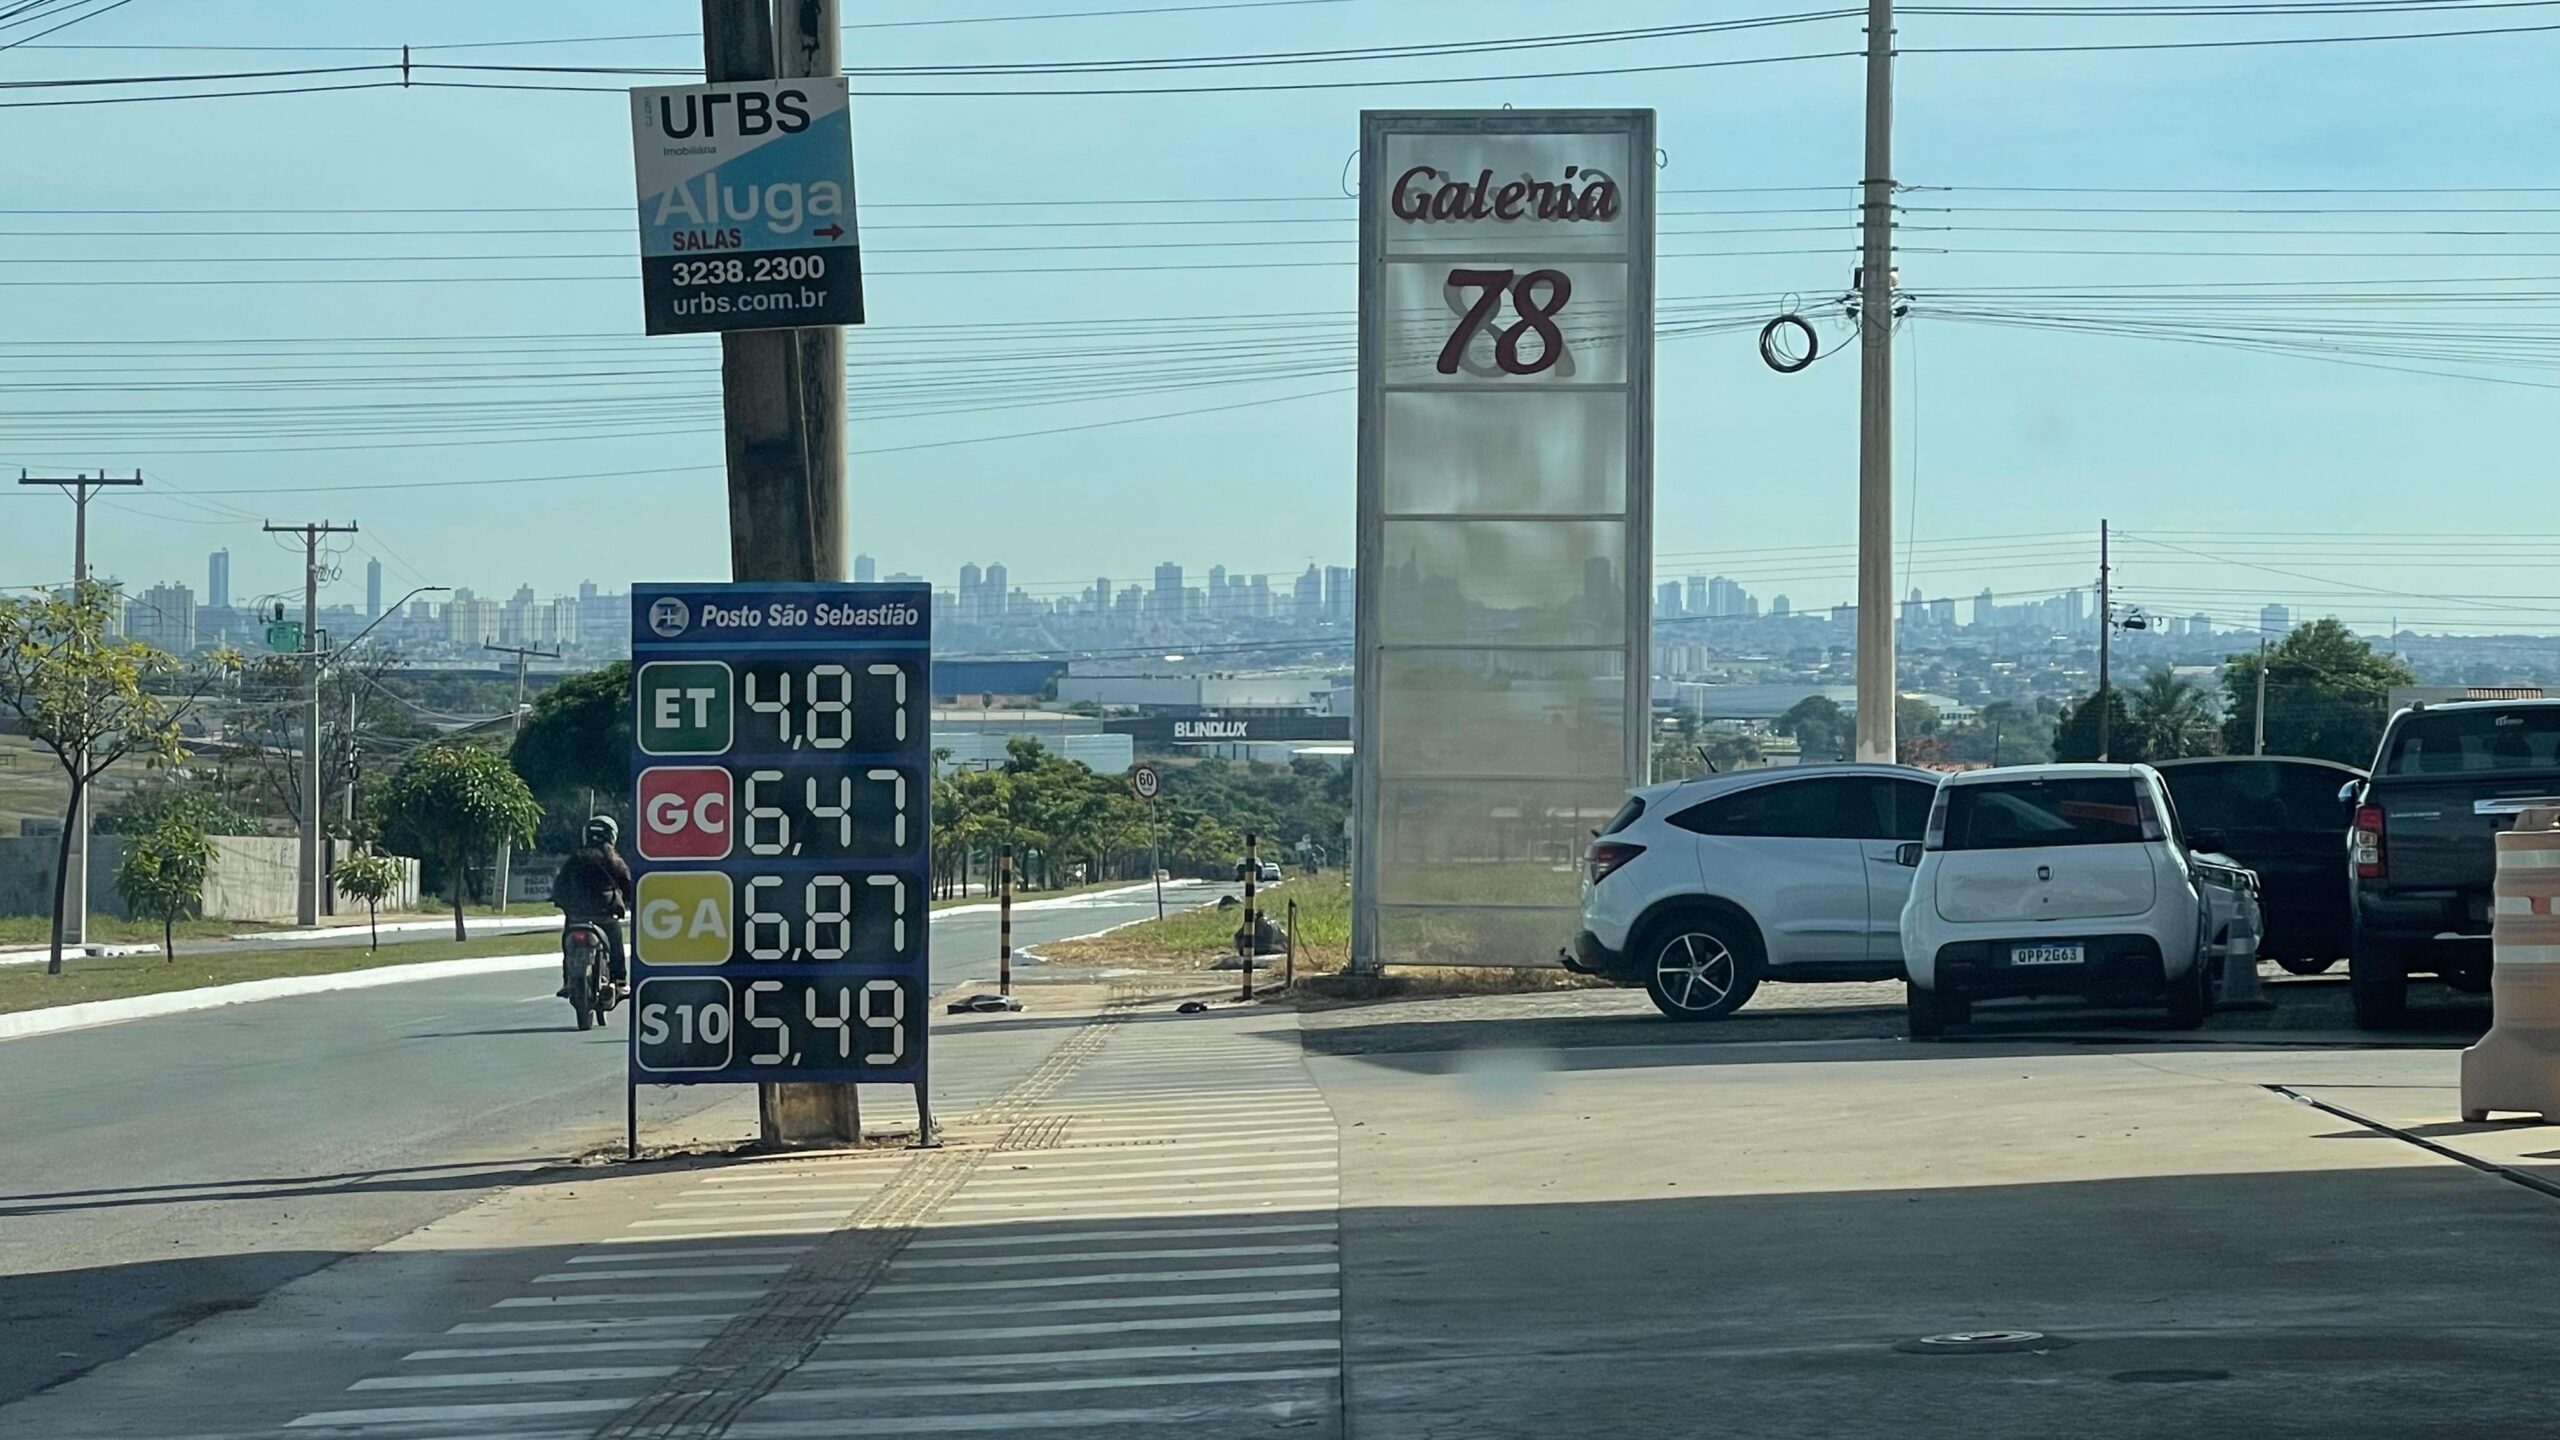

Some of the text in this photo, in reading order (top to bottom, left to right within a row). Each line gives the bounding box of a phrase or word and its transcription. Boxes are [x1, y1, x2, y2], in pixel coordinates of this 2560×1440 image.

[654, 172, 842, 234] Aluga
[1391, 165, 1619, 220] Galeria
[672, 228, 742, 251] SALAS
[672, 255, 826, 287] 3238.2300
[673, 286, 828, 316] urbs.com.br
[1437, 269, 1572, 375] 78
[701, 602, 919, 628] Posto São Sebastião
[655, 664, 907, 751] ET 4,87
[1138, 772, 1154, 786] 60
[646, 769, 907, 857] GC 6,47
[641, 875, 906, 962] GA 6,87
[2018, 948, 2078, 963] QPP2G63
[640, 980, 905, 1067] S10 5,49
